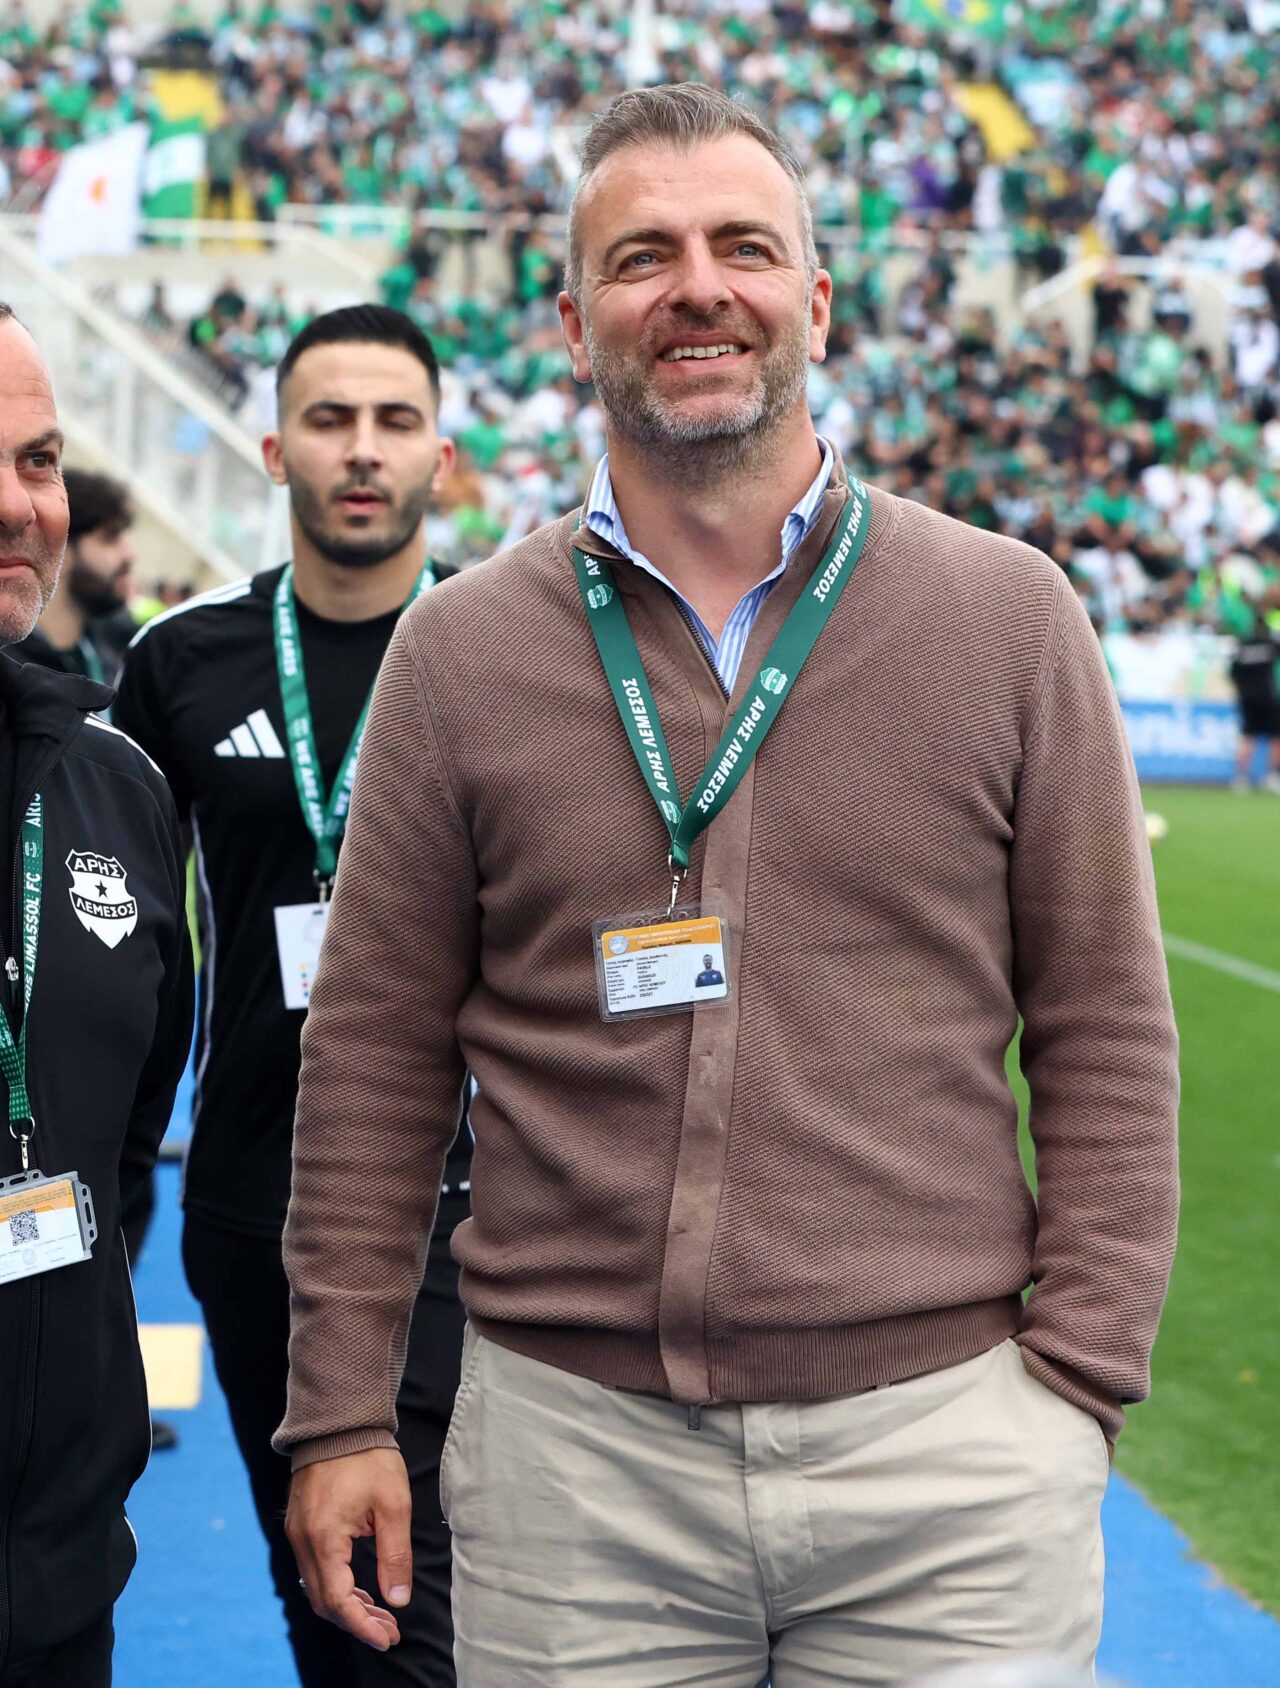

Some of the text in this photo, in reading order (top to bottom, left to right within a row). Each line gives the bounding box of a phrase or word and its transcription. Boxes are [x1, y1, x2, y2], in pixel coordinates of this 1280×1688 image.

[813, 495, 864, 602] ΑΡΗΣ ΛΕΜΕΣΟΣ
[622, 677, 670, 793] ΑΡΗΣ ΛΕΜΕΣΟΣ
[697, 695, 766, 814] ΑΡΗΣ ΛΕΜΕΣΟΣ
[26, 871, 41, 892] FC
[74, 857, 121, 878] ΑΡΗΣ
[76, 897, 135, 918] ΛΕΜΕΣΟΣ
[24, 893, 40, 973] LIMASSOL
